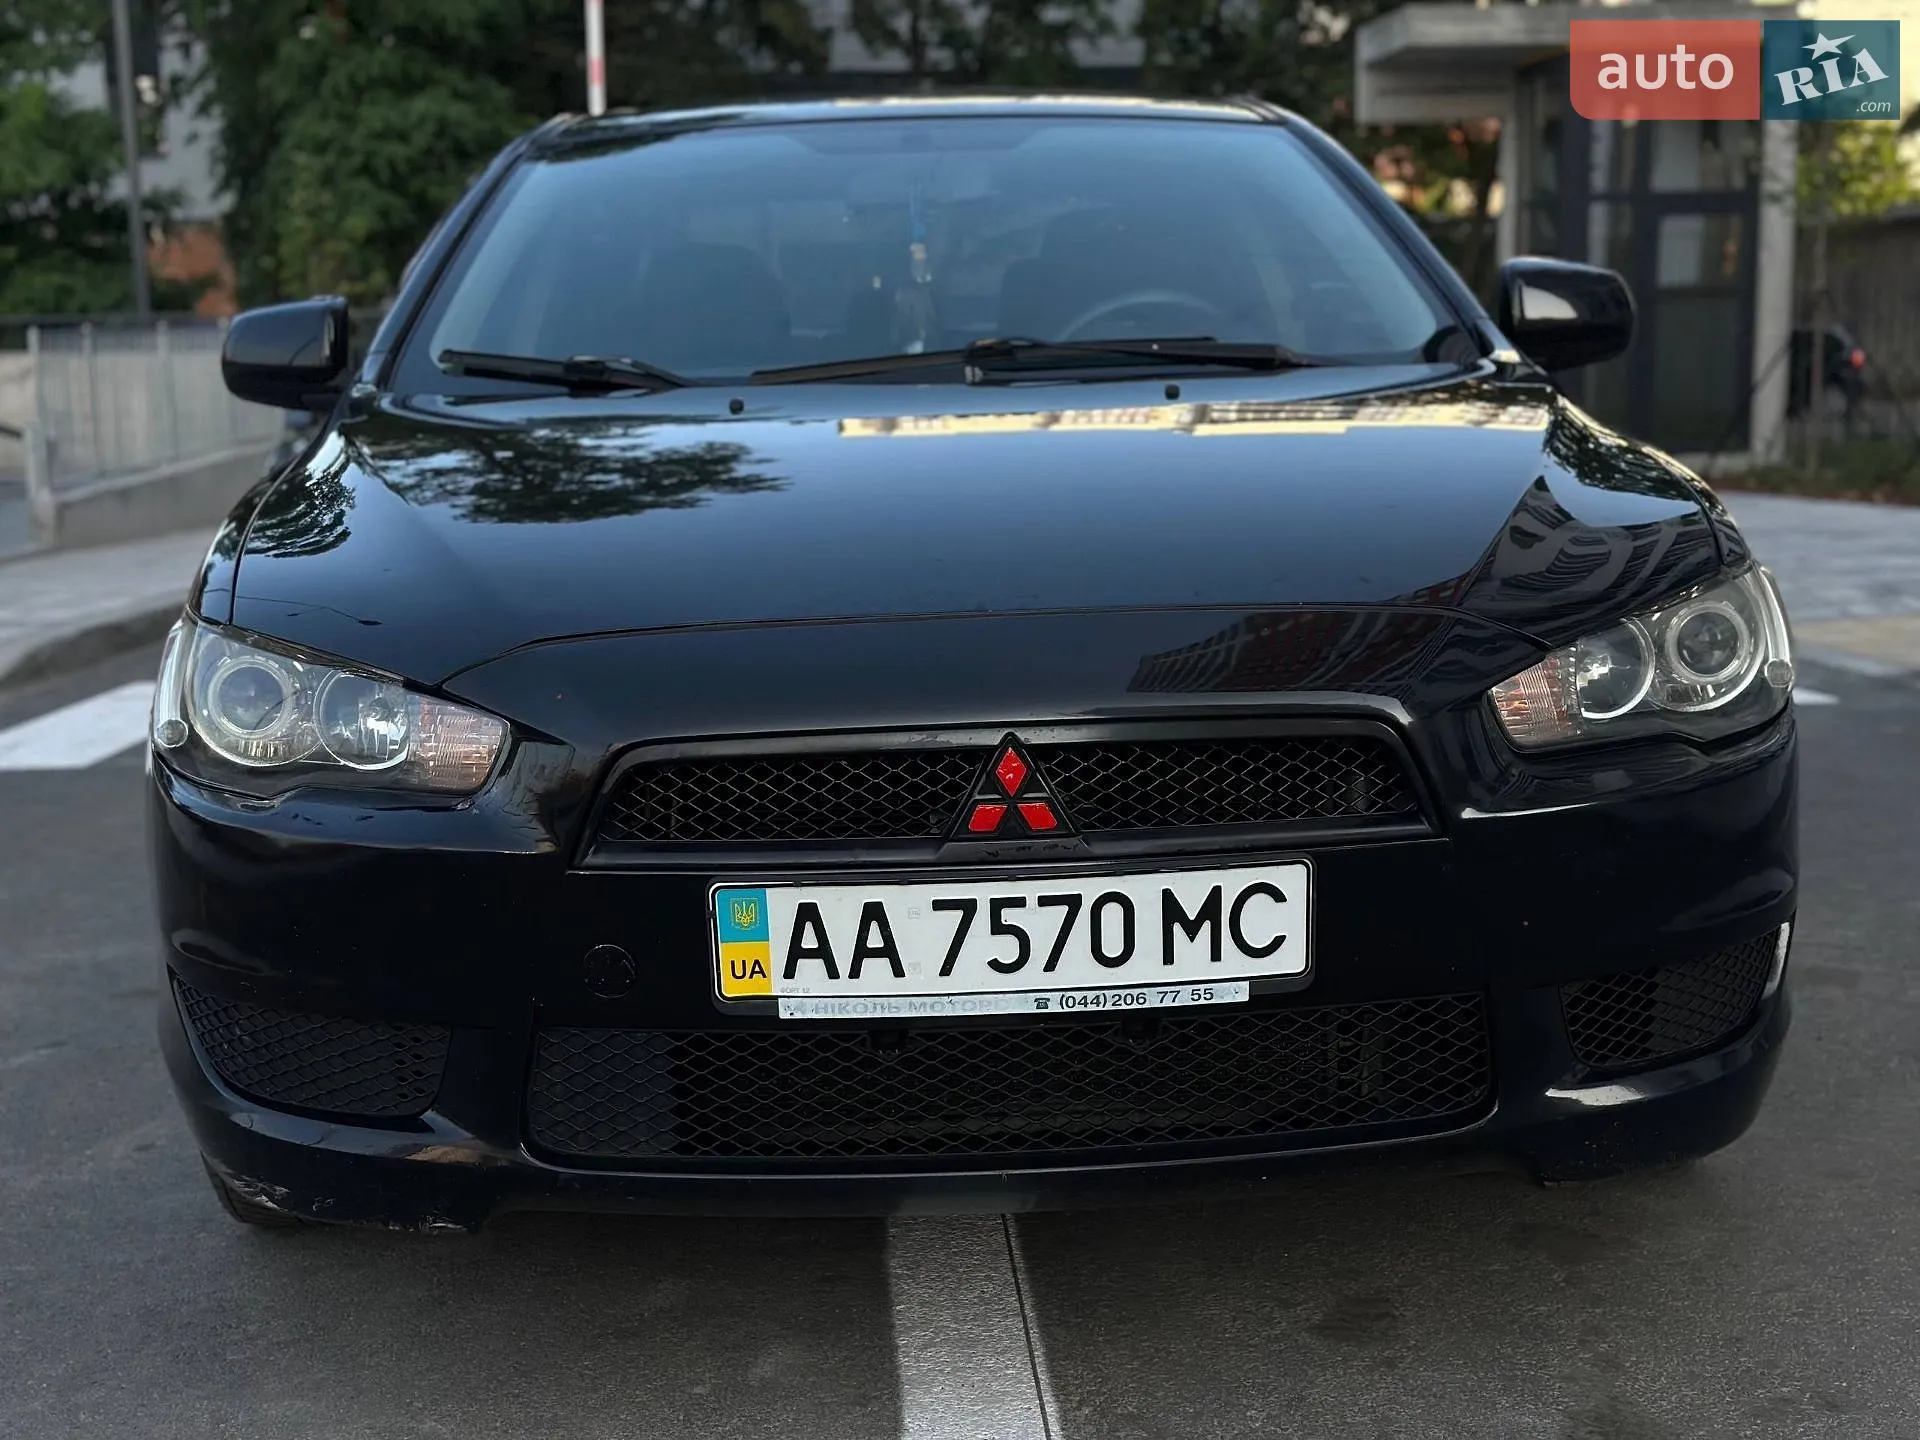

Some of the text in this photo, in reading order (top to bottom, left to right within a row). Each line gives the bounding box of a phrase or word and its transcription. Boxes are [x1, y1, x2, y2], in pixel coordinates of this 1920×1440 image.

[782, 881, 1288, 980] AA 7570 MC
[731, 960, 767, 980] UA
[1157, 990, 1181, 1004] 77
[1190, 988, 1214, 1001] 55
